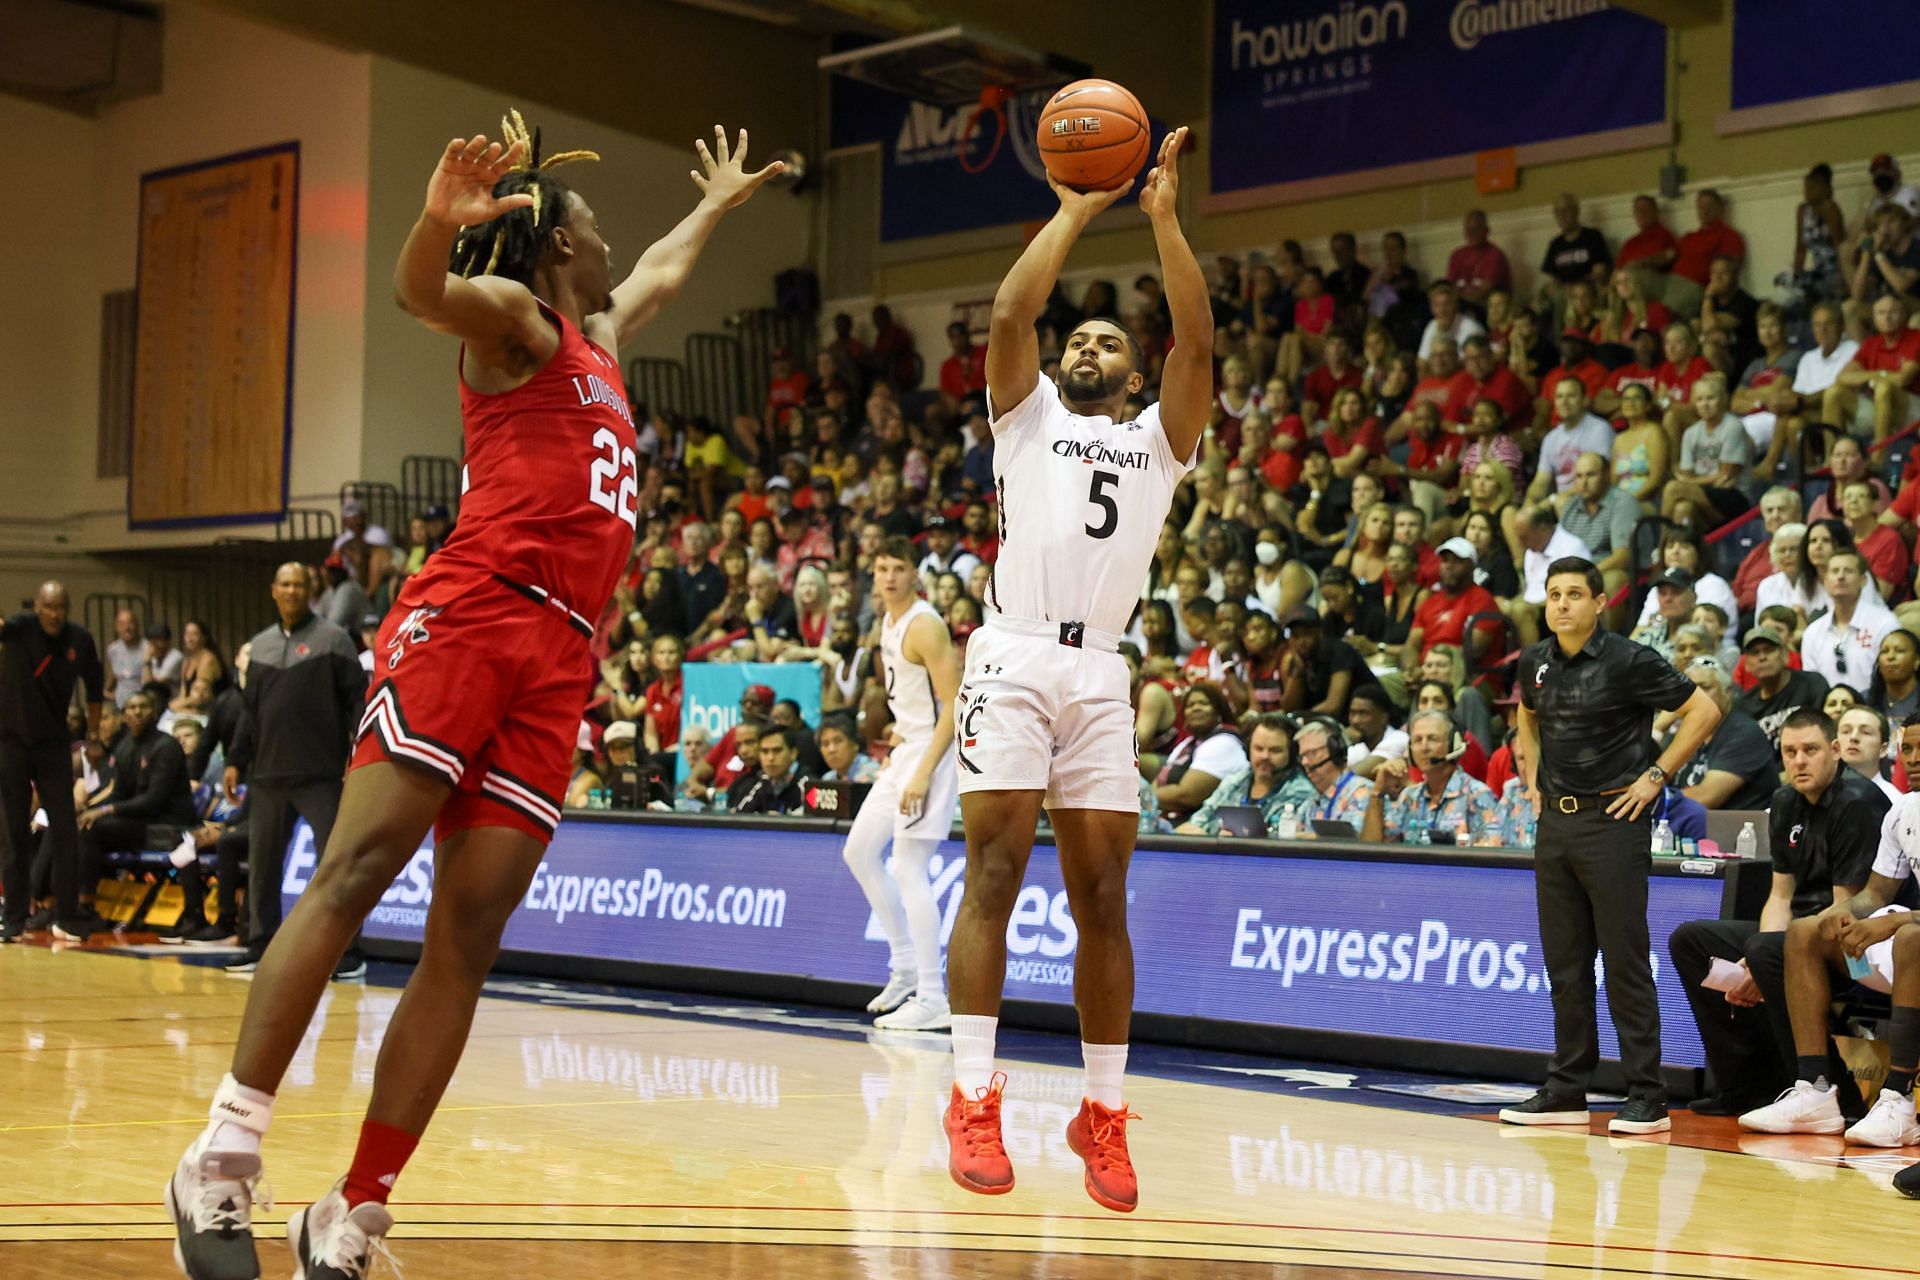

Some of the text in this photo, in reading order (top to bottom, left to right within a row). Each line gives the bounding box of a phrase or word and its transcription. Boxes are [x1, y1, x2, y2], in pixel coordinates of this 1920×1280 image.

[1450, 0, 1609, 50] Continenta
[1052, 117, 1100, 136] ELITE
[572, 374, 635, 428] LOUISVIL
[589, 427, 637, 531] 22
[1052, 440, 1149, 470] CINCINNATI
[1085, 470, 1119, 539] 5
[816, 788, 839, 810] POSS
[525, 862, 786, 928] ExpressPros.com
[1230, 908, 1660, 994] ExpressPros.
